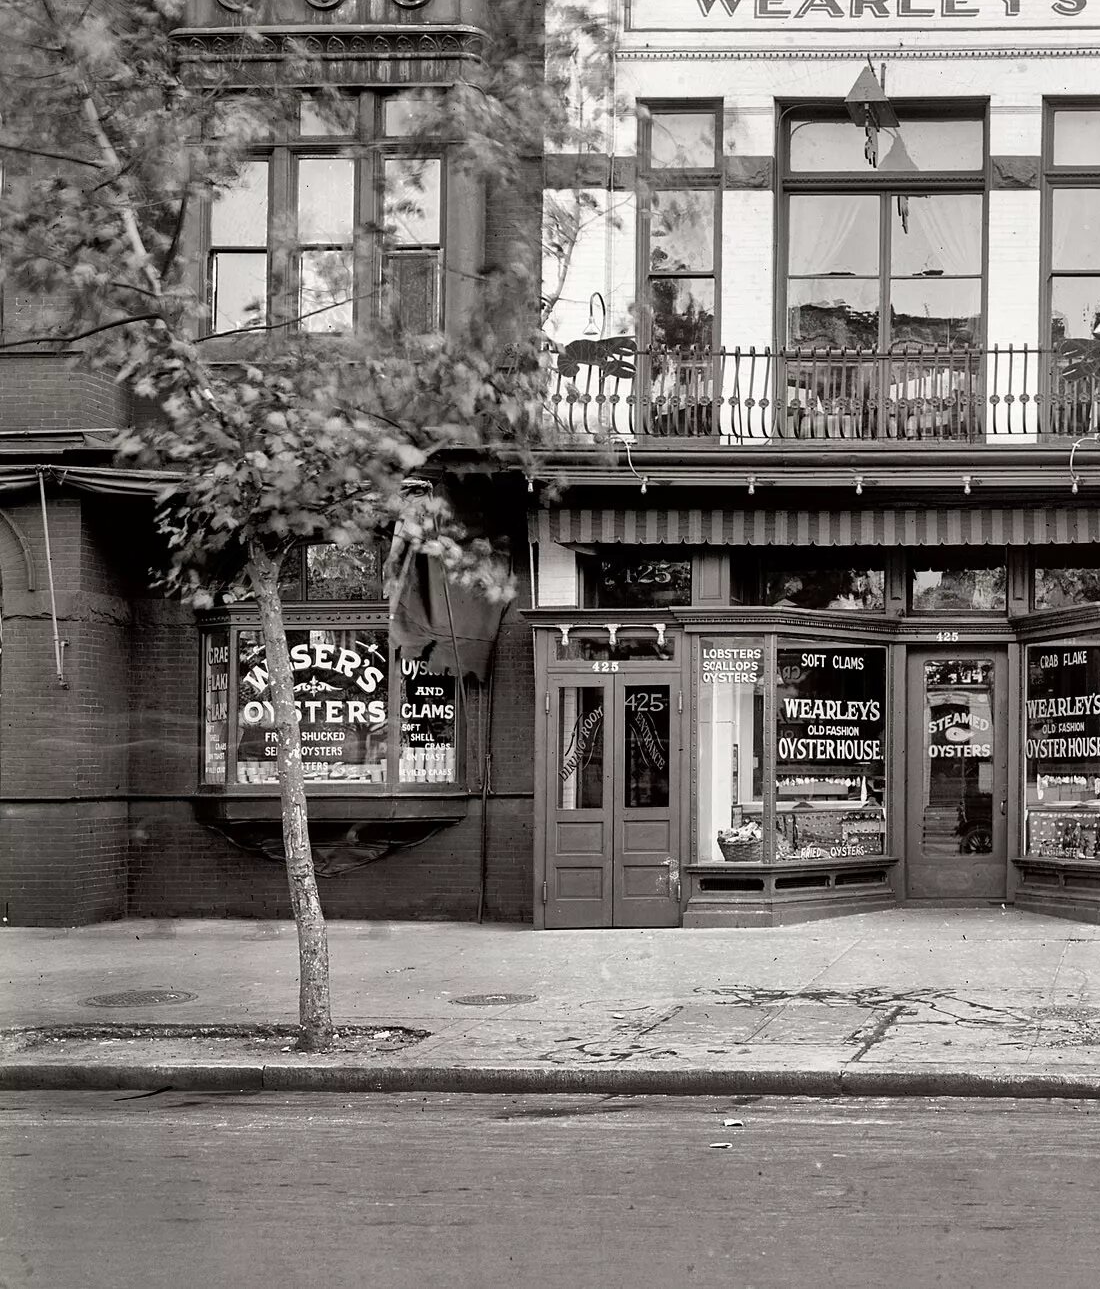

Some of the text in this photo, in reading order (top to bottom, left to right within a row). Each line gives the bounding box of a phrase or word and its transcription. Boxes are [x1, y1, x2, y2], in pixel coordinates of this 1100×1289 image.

[936, 632, 959, 642] 425
[703, 649, 761, 659] LOBSTERS
[1040, 650, 1088, 669] CRAB FLAKE
[592, 662, 619, 672] 425
[703, 661, 759, 671] SCALLOPS
[801, 653, 864, 671] SOFT CLAMS
[703, 672, 758, 683] OYSTERS
[415, 687, 444, 696] AND
[625, 693, 664, 711] 425
[401, 703, 455, 720] CLAMS
[785, 698, 880, 722] WEARLEY'S
[401, 723, 421, 732] SOFT
[928, 713, 990, 733] STEAMED
[1042, 722, 1085, 734] OLD FASHION
[301, 732, 345, 741] SHUCKED
[808, 725, 860, 737] OLD FASHION
[410, 733, 434, 742] SHELL
[635, 712, 666, 770] ENTRANCE
[424, 743, 451, 751] CRABS
[559, 706, 604, 781] DINING ROOM
[779, 738, 835, 760] OYSTER
[1026, 739, 1066, 759] OYSTER
[301, 747, 343, 756] OYSTERS
[928, 744, 991, 758] OYSTERS
[420, 753, 446, 761] TOAST
[801, 847, 822, 858] FRIED
